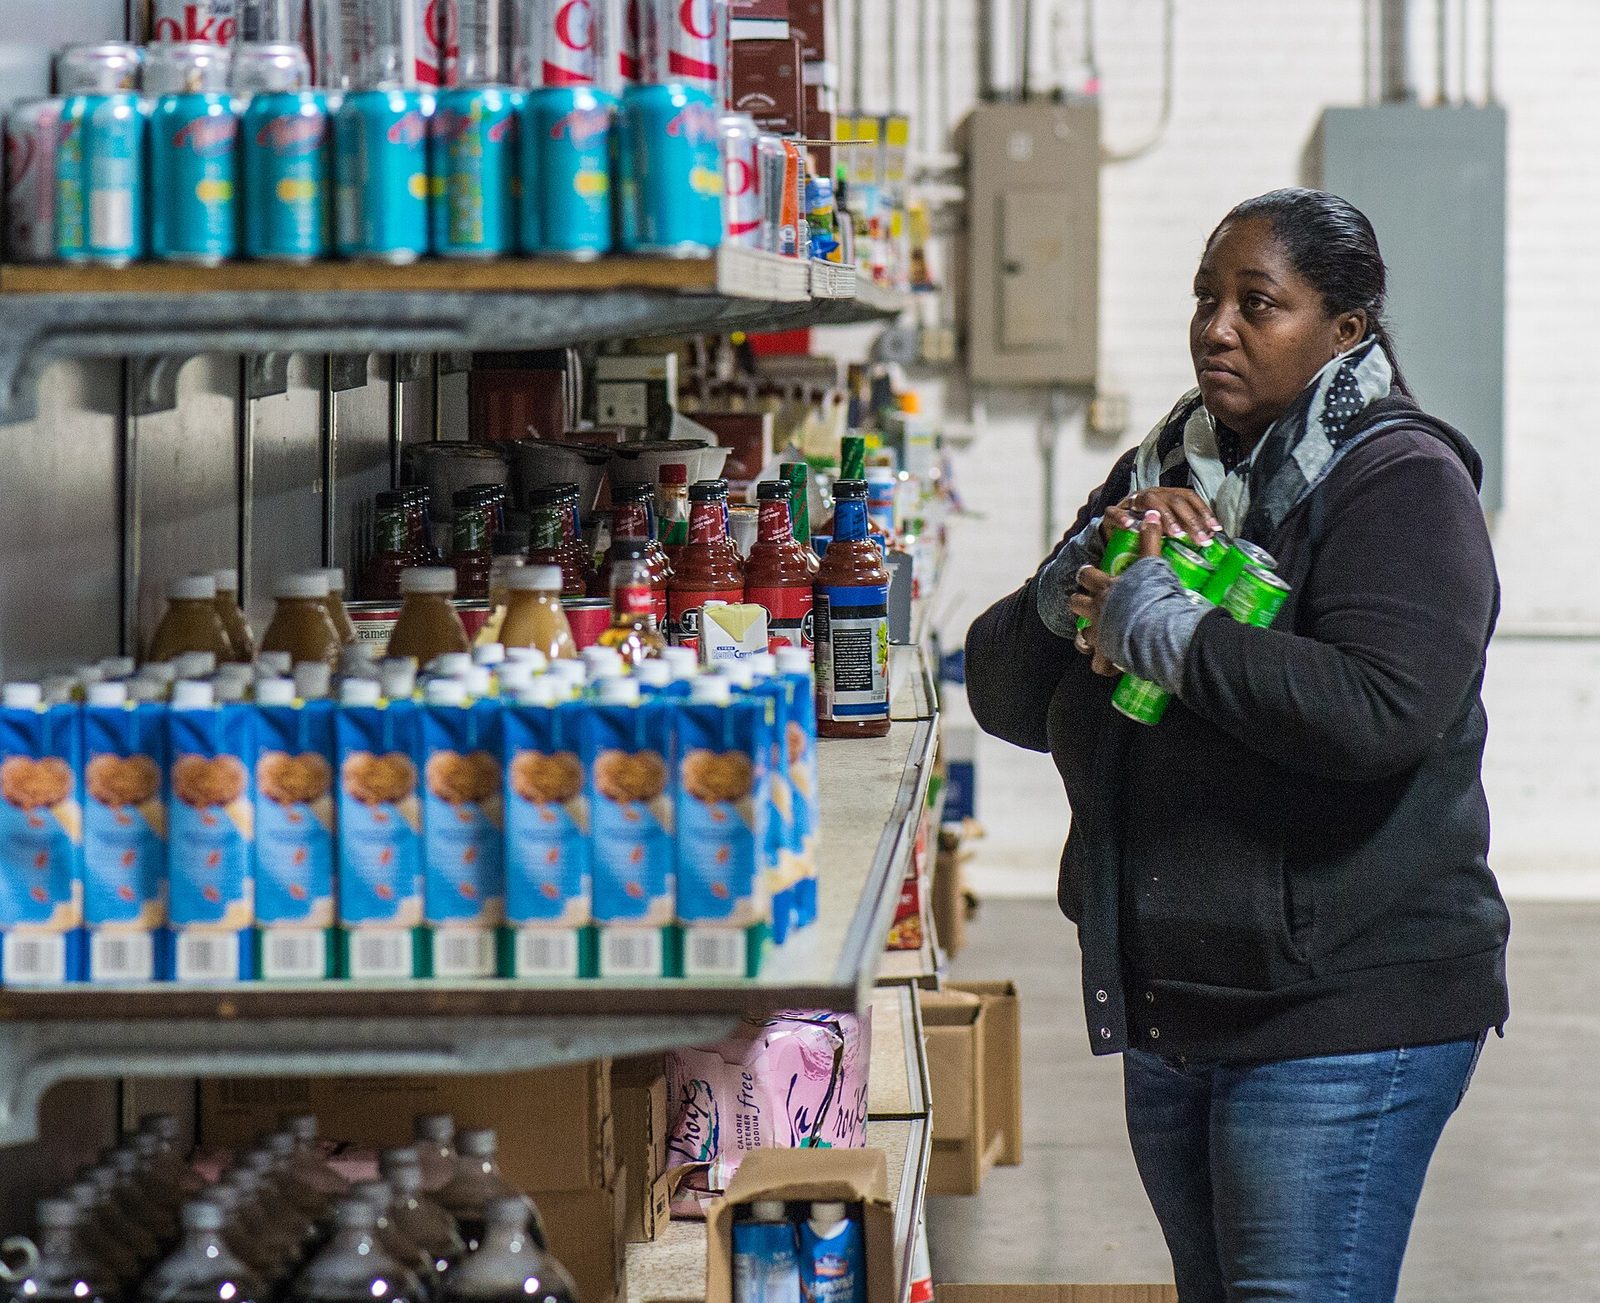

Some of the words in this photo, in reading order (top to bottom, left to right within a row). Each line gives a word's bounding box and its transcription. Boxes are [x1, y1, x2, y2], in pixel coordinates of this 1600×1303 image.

[736, 1071, 760, 1113] free
[735, 1113, 744, 1150] CALORIE
[752, 1115, 761, 1146] SODIUM
